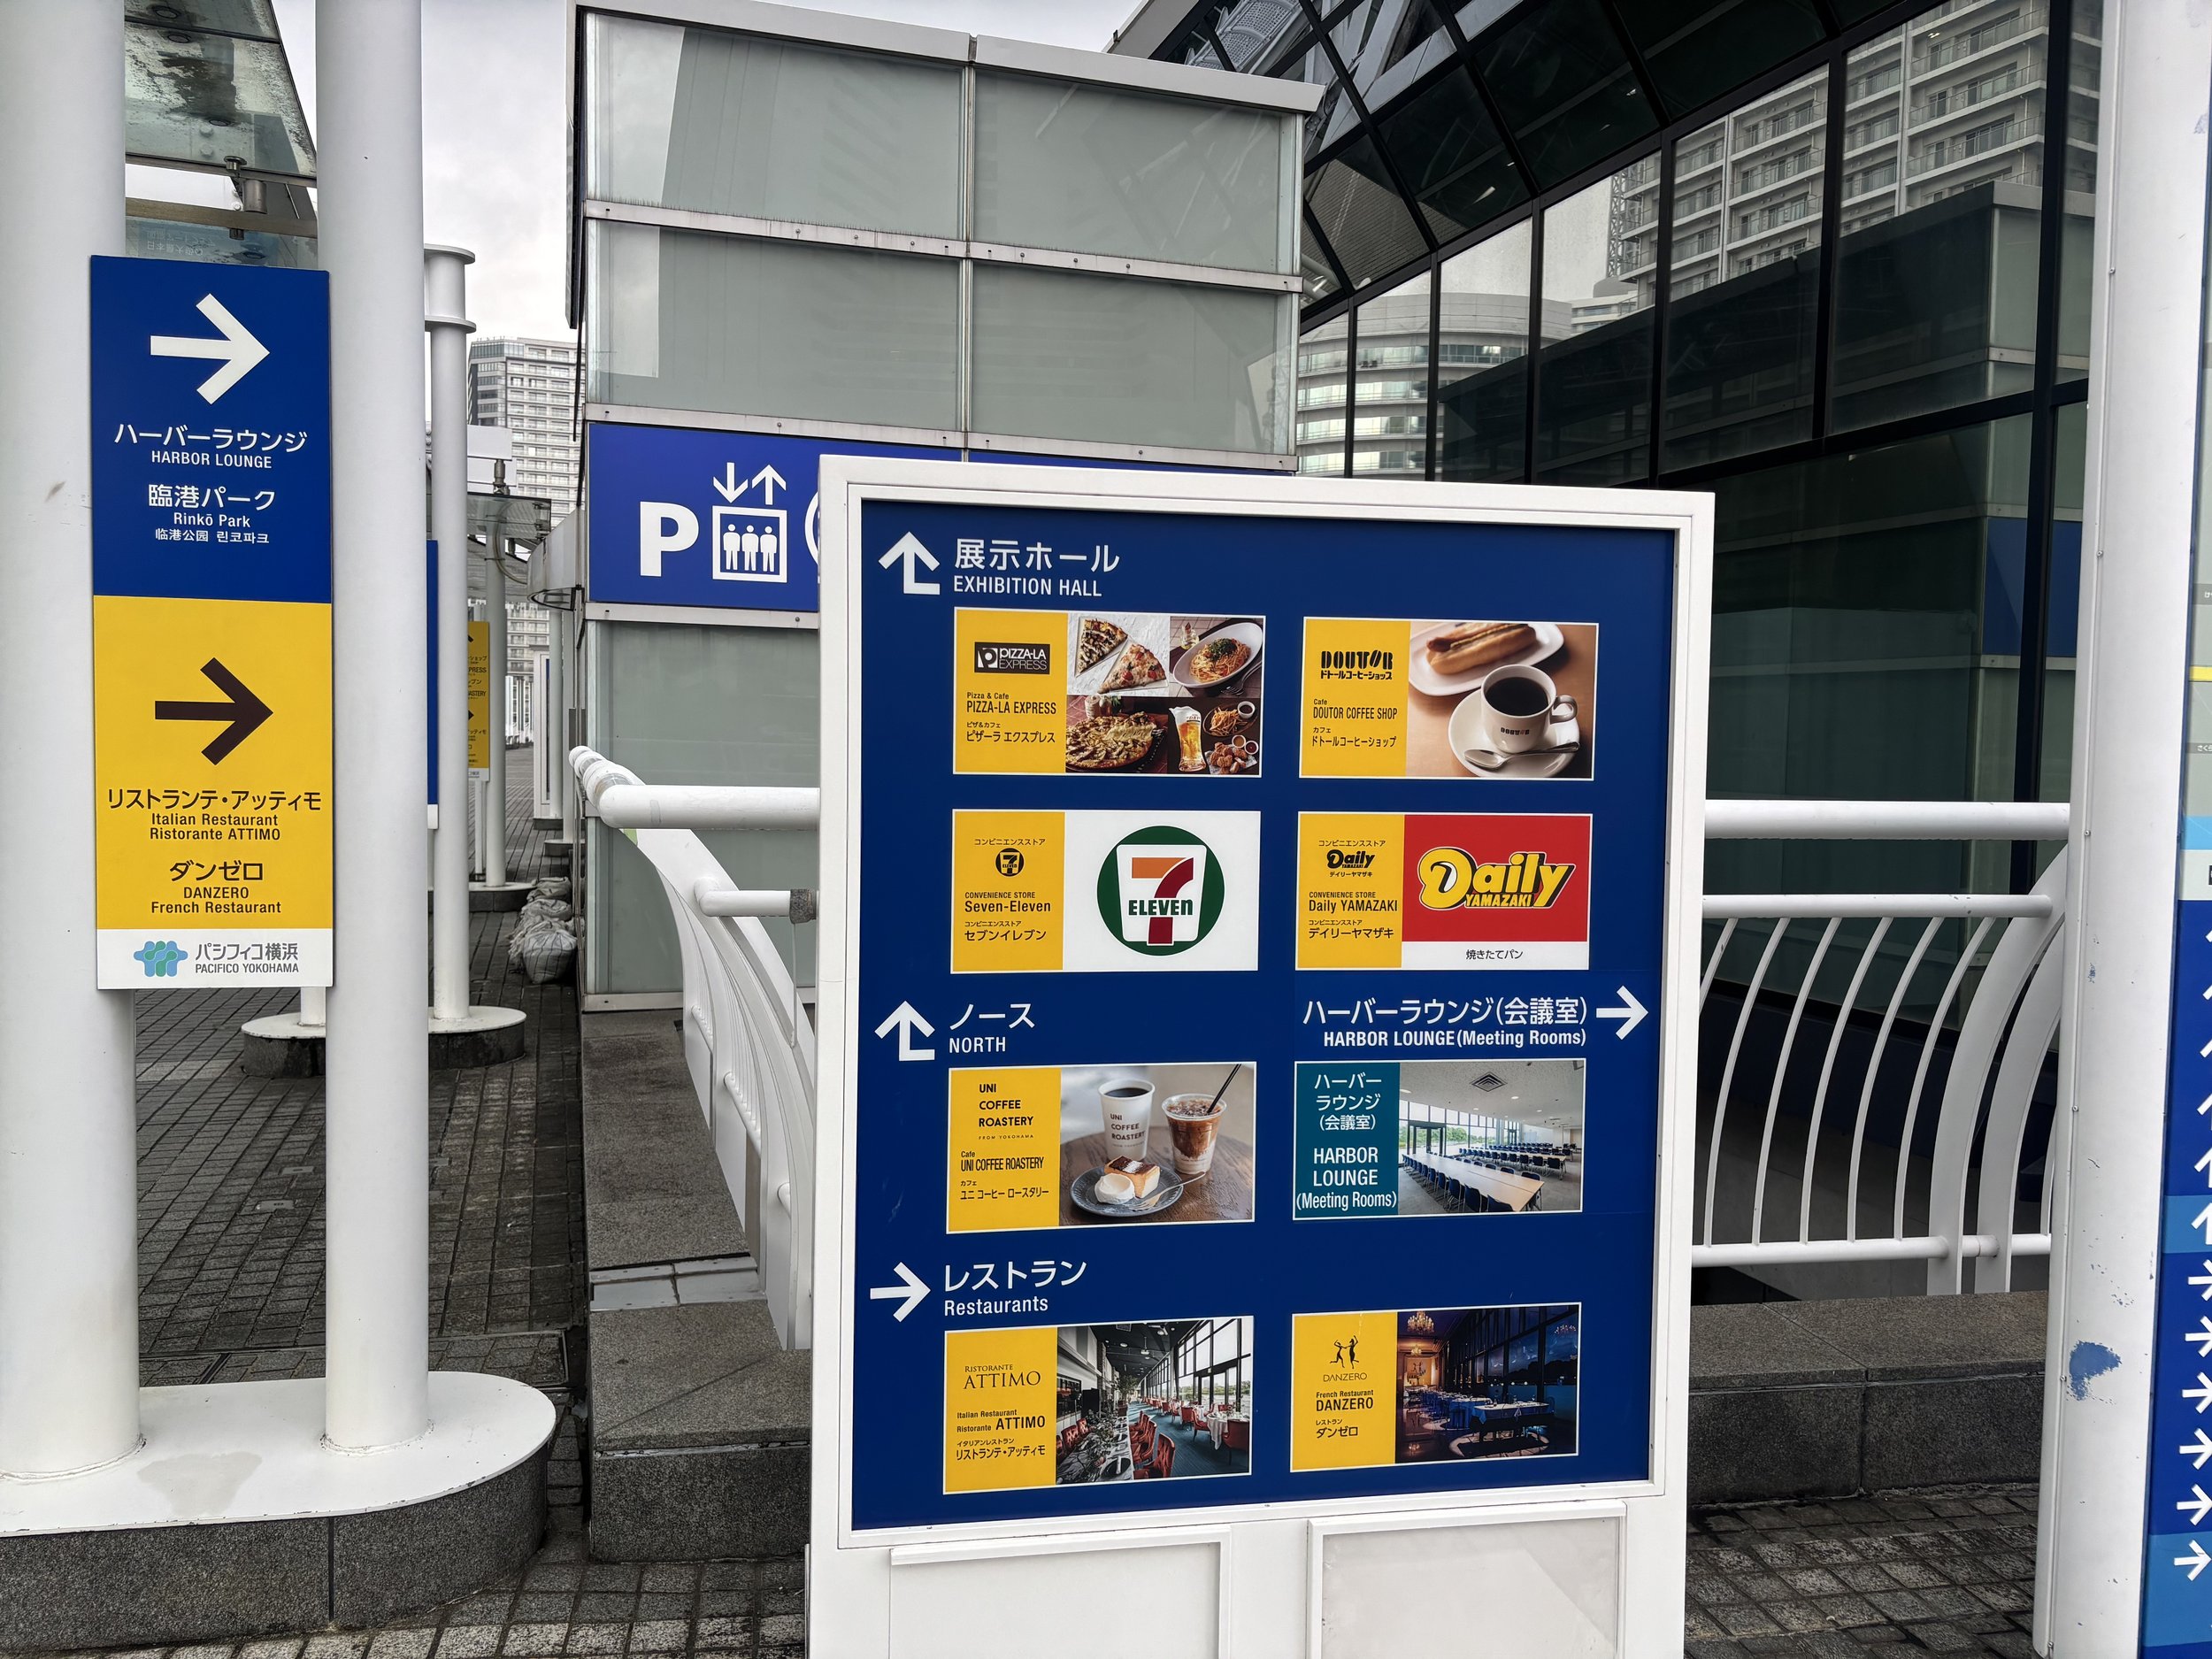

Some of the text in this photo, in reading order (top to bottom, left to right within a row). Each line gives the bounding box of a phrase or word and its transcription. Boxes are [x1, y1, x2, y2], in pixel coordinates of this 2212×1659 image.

[114, 423, 308, 452] ハーバーラウンジ
[151, 450, 272, 468] HARBOR LOUNGE
[149, 484, 275, 511] 臨港パーク
[173, 512, 250, 527] Rinkō Park
[156, 529, 209, 542] 临港公园
[217, 532, 269, 544] 린코파크
[641, 502, 699, 577] P
[955, 538, 1119, 572] 展示ホール
[954, 576, 1102, 596] EXHIBITION HALL
[1000, 648, 1046, 659] PIZZA-LA
[1321, 650, 1393, 670] DOUTOR
[999, 659, 1047, 670] EXPRESS
[1321, 670, 1392, 680] ドトールコーヒーショップ
[967, 701, 1056, 714] PIZZA-LA EXPRESS
[1314, 707, 1397, 719] DOUTOR COFFEE SHOP
[967, 730, 1055, 742] ピザーラ エクスプレス
[1312, 736, 1396, 747] ドトールコーヒーショップ
[109, 788, 321, 810] リストランテ・アッティモ
[151, 813, 278, 826] Italian Restaurant
[150, 828, 280, 840] Ristorante ATTIMO
[1327, 849, 1375, 869] Daily
[170, 860, 263, 881] ダンゼロ
[1418, 847, 1575, 910] Daily
[183, 887, 249, 898] DANZERO
[151, 902, 281, 913] French Restaurant
[965, 901, 1050, 912] Seven-Eleven
[1310, 900, 1397, 913] Daily YAMAZAKI
[1465, 894, 1532, 907] YAMAZAKI
[964, 930, 1046, 941] セブンイレブン
[1309, 927, 1394, 938] デイリーヤマザキ
[196, 942, 298, 961] パシフィコ横浜
[1466, 949, 1523, 960] 焼きたてパン
[196, 964, 299, 973] PACIFICO YOKOHAMA
[949, 1004, 1034, 1030] ノース
[949, 1037, 1006, 1053] NORTH
[1325, 1031, 1388, 1047] HARBOR
[1530, 1030, 1586, 1046] Rooms)
[1314, 1072, 1381, 1089] ハーバー
[979, 1084, 996, 1093] UNI
[979, 1100, 1020, 1110] COFFEE
[1317, 1094, 1380, 1110] ラウンジ
[979, 1117, 1033, 1126] ROASTERY
[1111, 1131, 1145, 1140] ROASTERY
[1314, 1147, 1379, 1164] HARBOR
[961, 1156, 1044, 1171] UNI COFFEE ROASTERY
[1313, 1170, 1378, 1187] LOUNGE
[978, 1189, 1005, 1199] コーヒー
[1008, 1187, 1048, 1197] ロースタリー
[1296, 1191, 1396, 1210] (Meeting Rooms)
[945, 1261, 1087, 1292] レストラン
[945, 1296, 1048, 1316] Restaurants
[964, 1371, 1041, 1389] ATTIMO
[1324, 1372, 1367, 1382] DANZERO
[1317, 1397, 1373, 1411] DANZERO
[996, 1416, 1045, 1430] ATTIMO
[1317, 1425, 1358, 1439] ダンゼロ
[956, 1445, 1045, 1460] リストランテ・アッティモ
